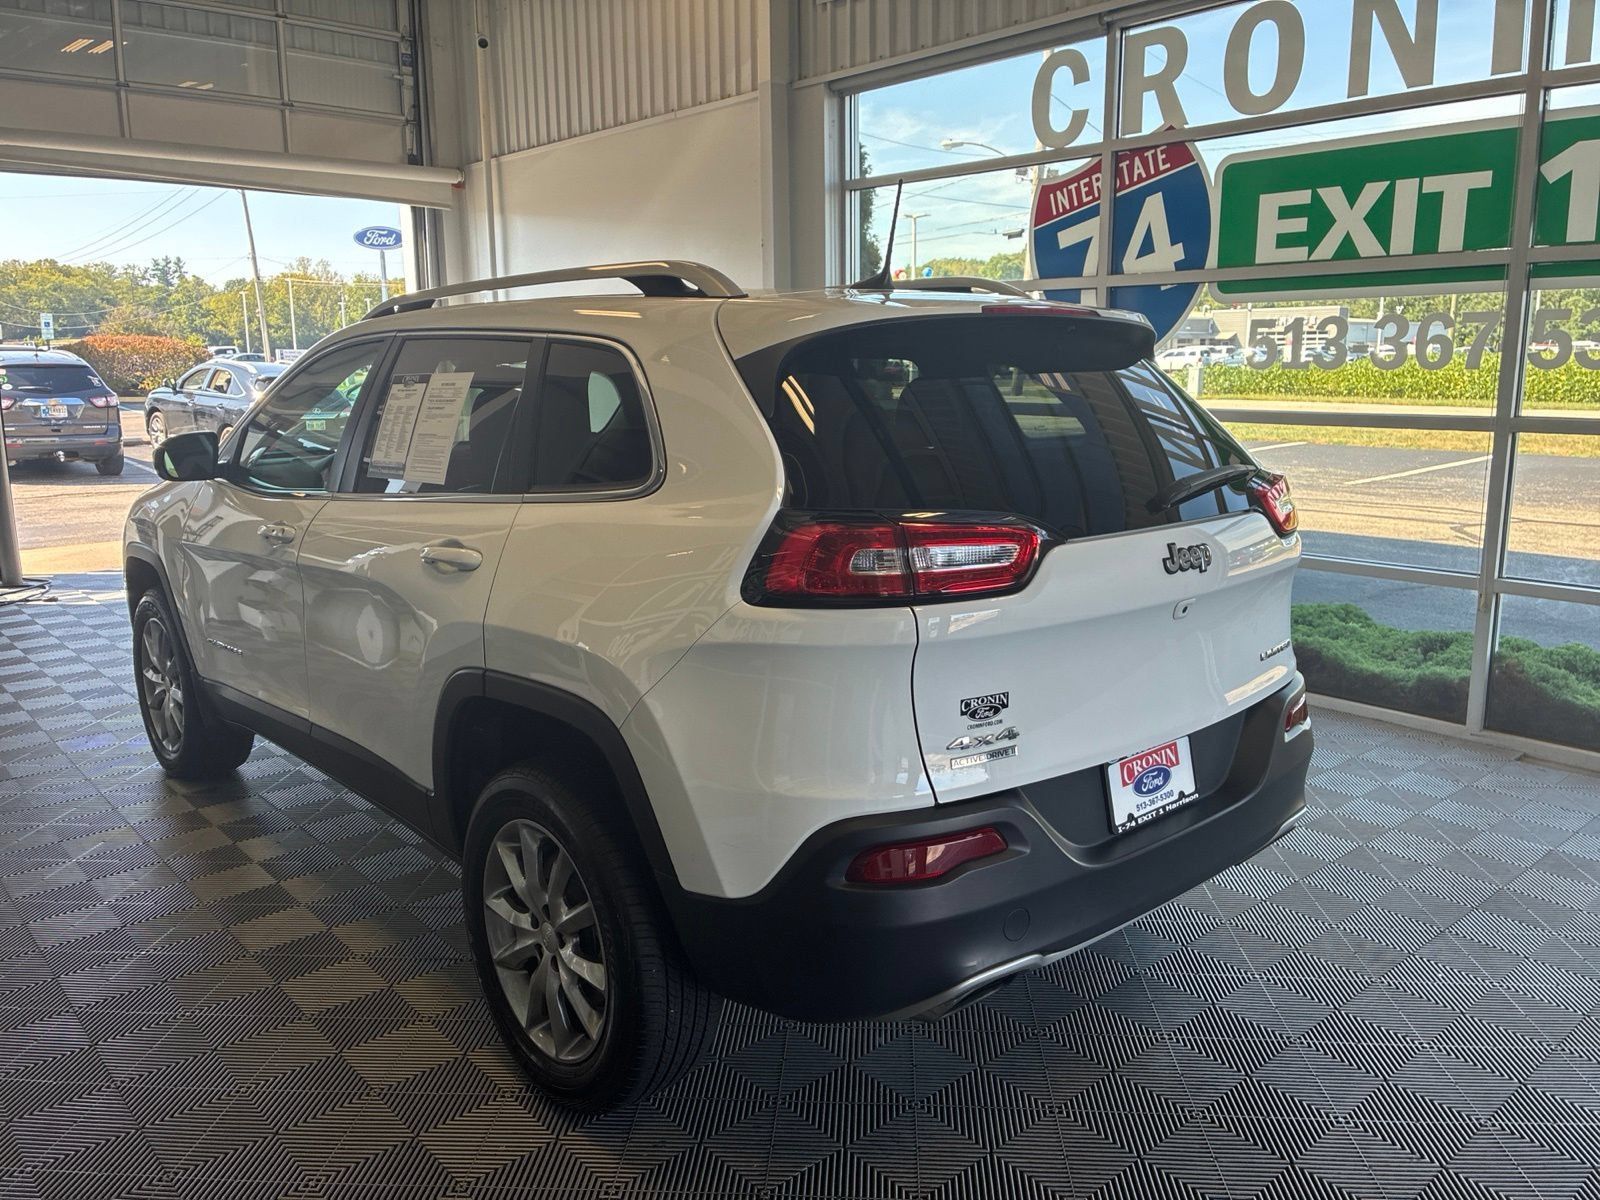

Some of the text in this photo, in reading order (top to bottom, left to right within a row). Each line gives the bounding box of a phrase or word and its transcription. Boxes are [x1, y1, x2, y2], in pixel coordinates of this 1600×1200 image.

[1050, 146, 1171, 216] INTERTATE
[1255, 170, 1493, 265] EXIT
[363, 229, 396, 246] Ford
[1057, 191, 1185, 305] 74
[1162, 542, 1212, 575] Jeep
[961, 693, 1008, 712] CRONIN
[975, 706, 995, 719] Ford
[953, 754, 986, 767] ACTIVE
[986, 747, 1010, 760] DRIVE
[1123, 745, 1177, 784] CRONIN
[1141, 771, 1164, 792] Ford
[1118, 820, 1136, 833] I-74
[1137, 810, 1157, 824] EXIT
[1166, 793, 1199, 811] Harrison
[1136, 789, 1174, 812] 513-367-5300
